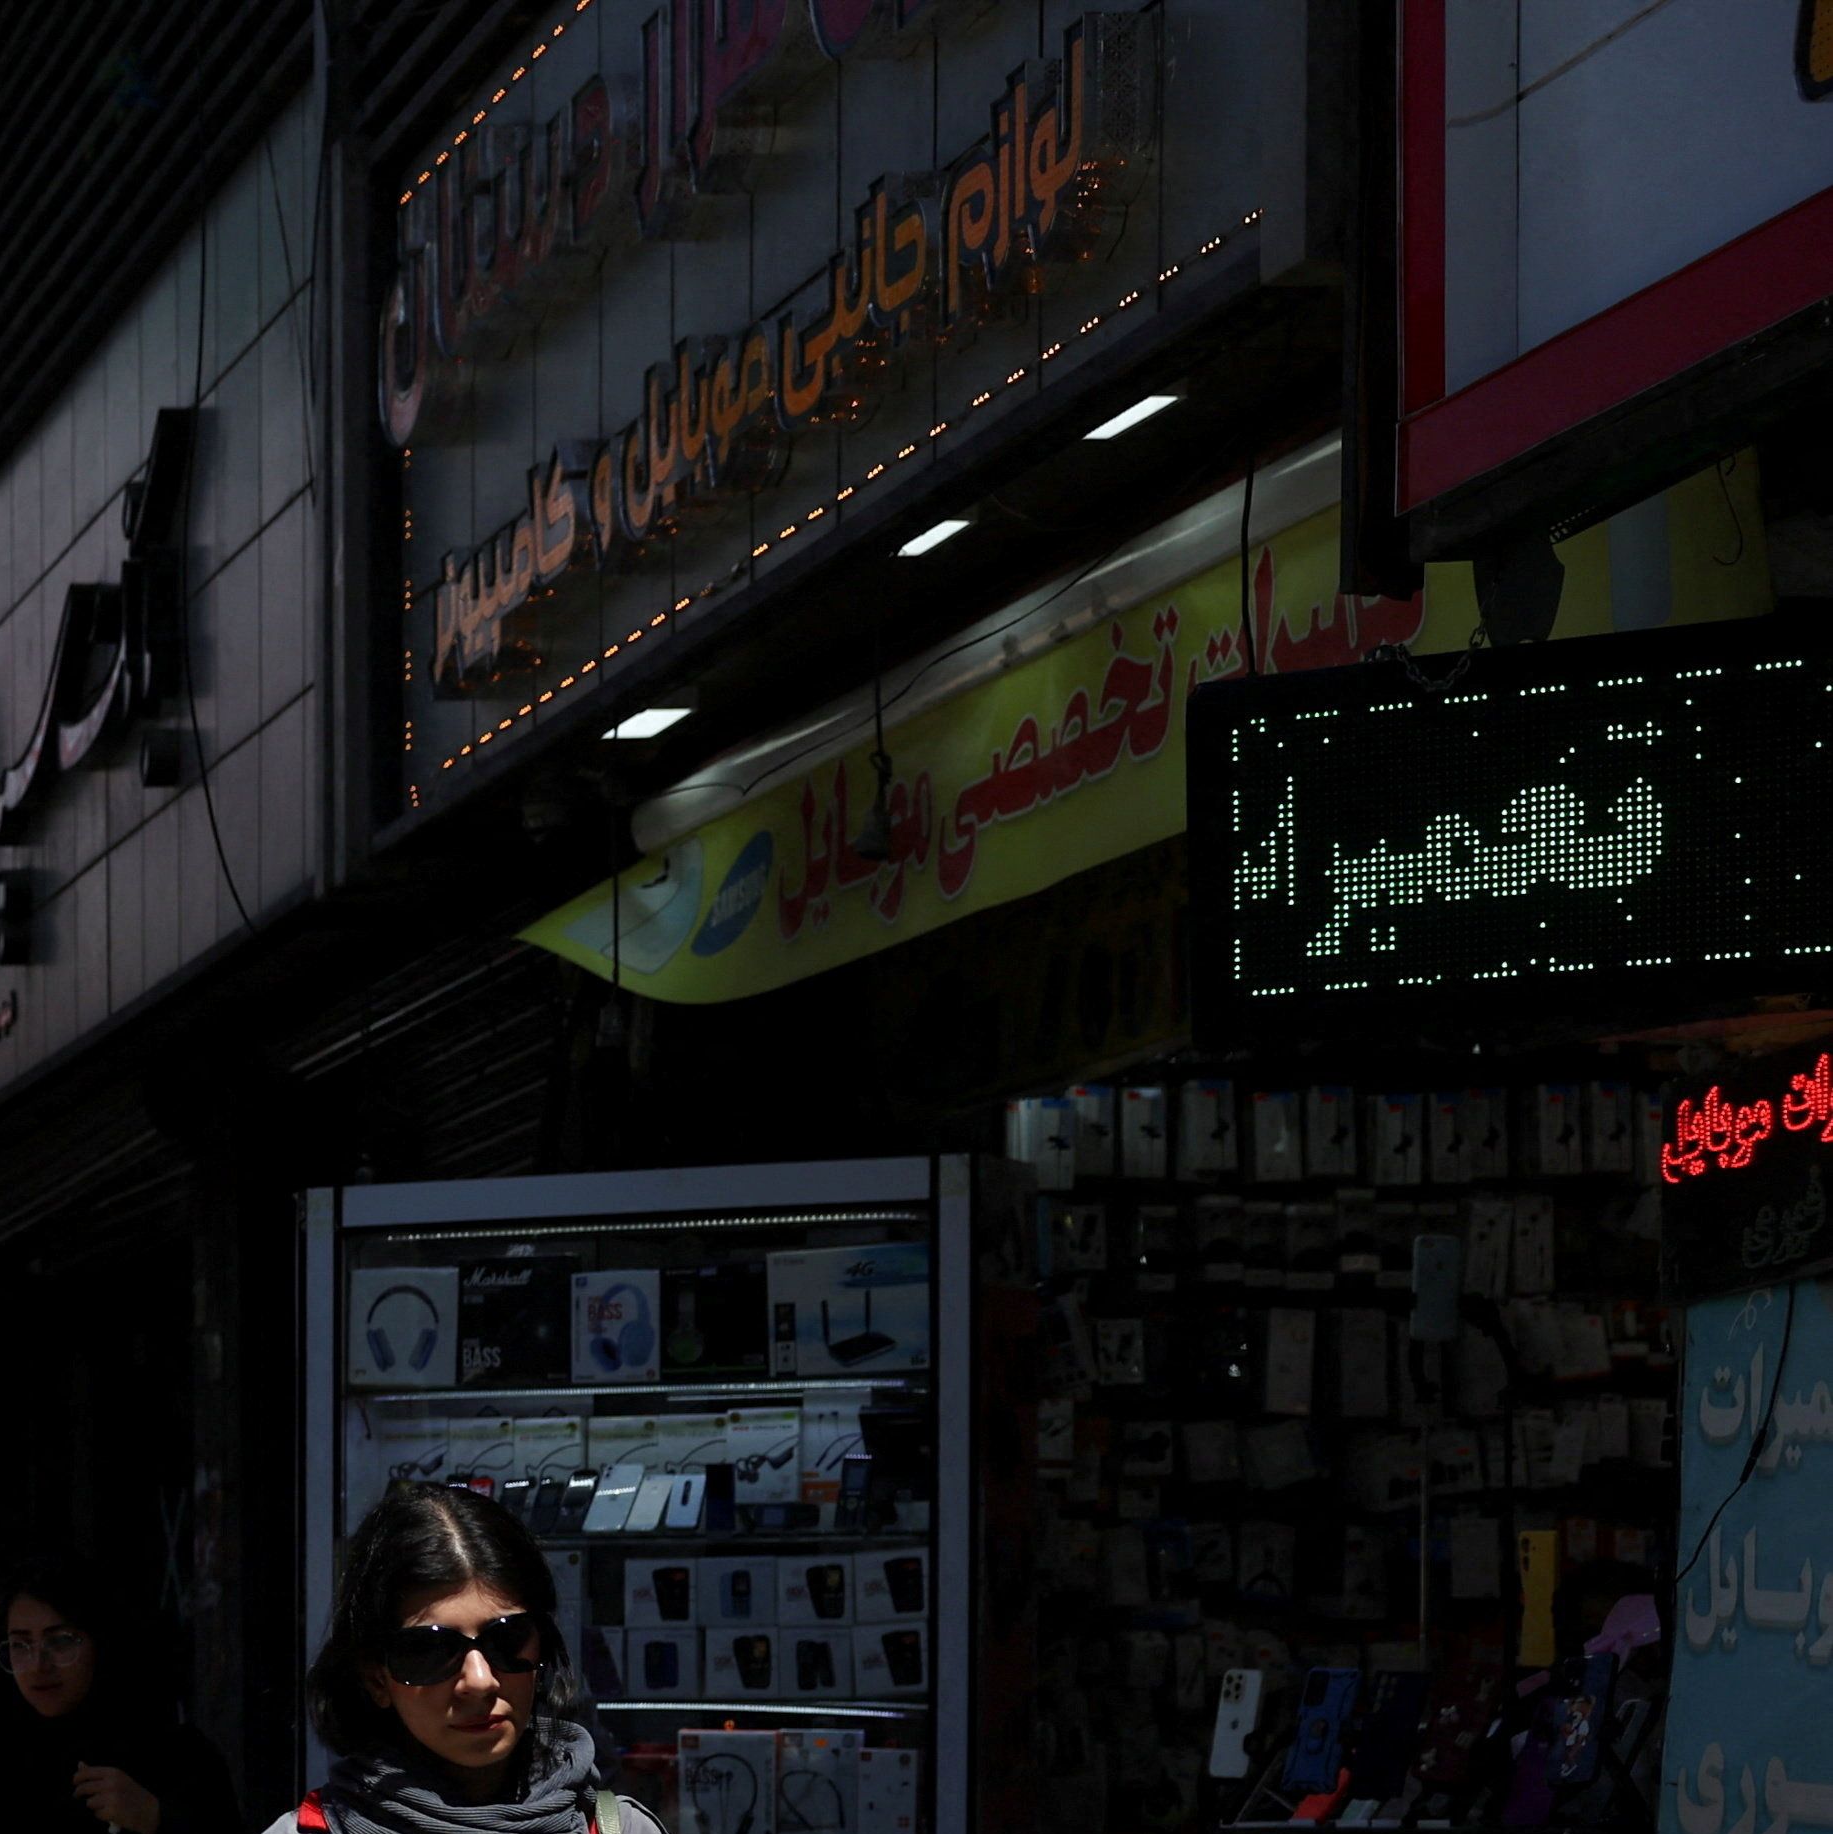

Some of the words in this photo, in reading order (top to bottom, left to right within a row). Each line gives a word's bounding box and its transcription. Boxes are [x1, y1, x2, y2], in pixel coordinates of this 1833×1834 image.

[944, 36, 1085, 330] لوازم
[781, 180, 926, 418] جانبی
[619, 332, 771, 540] موبایل
[937, 604, 1182, 900] تخصصی
[1661, 1084, 1774, 1185] موبایل
[461, 1346, 502, 1369] BASS
[462, 1265, 533, 1289] Marshall
